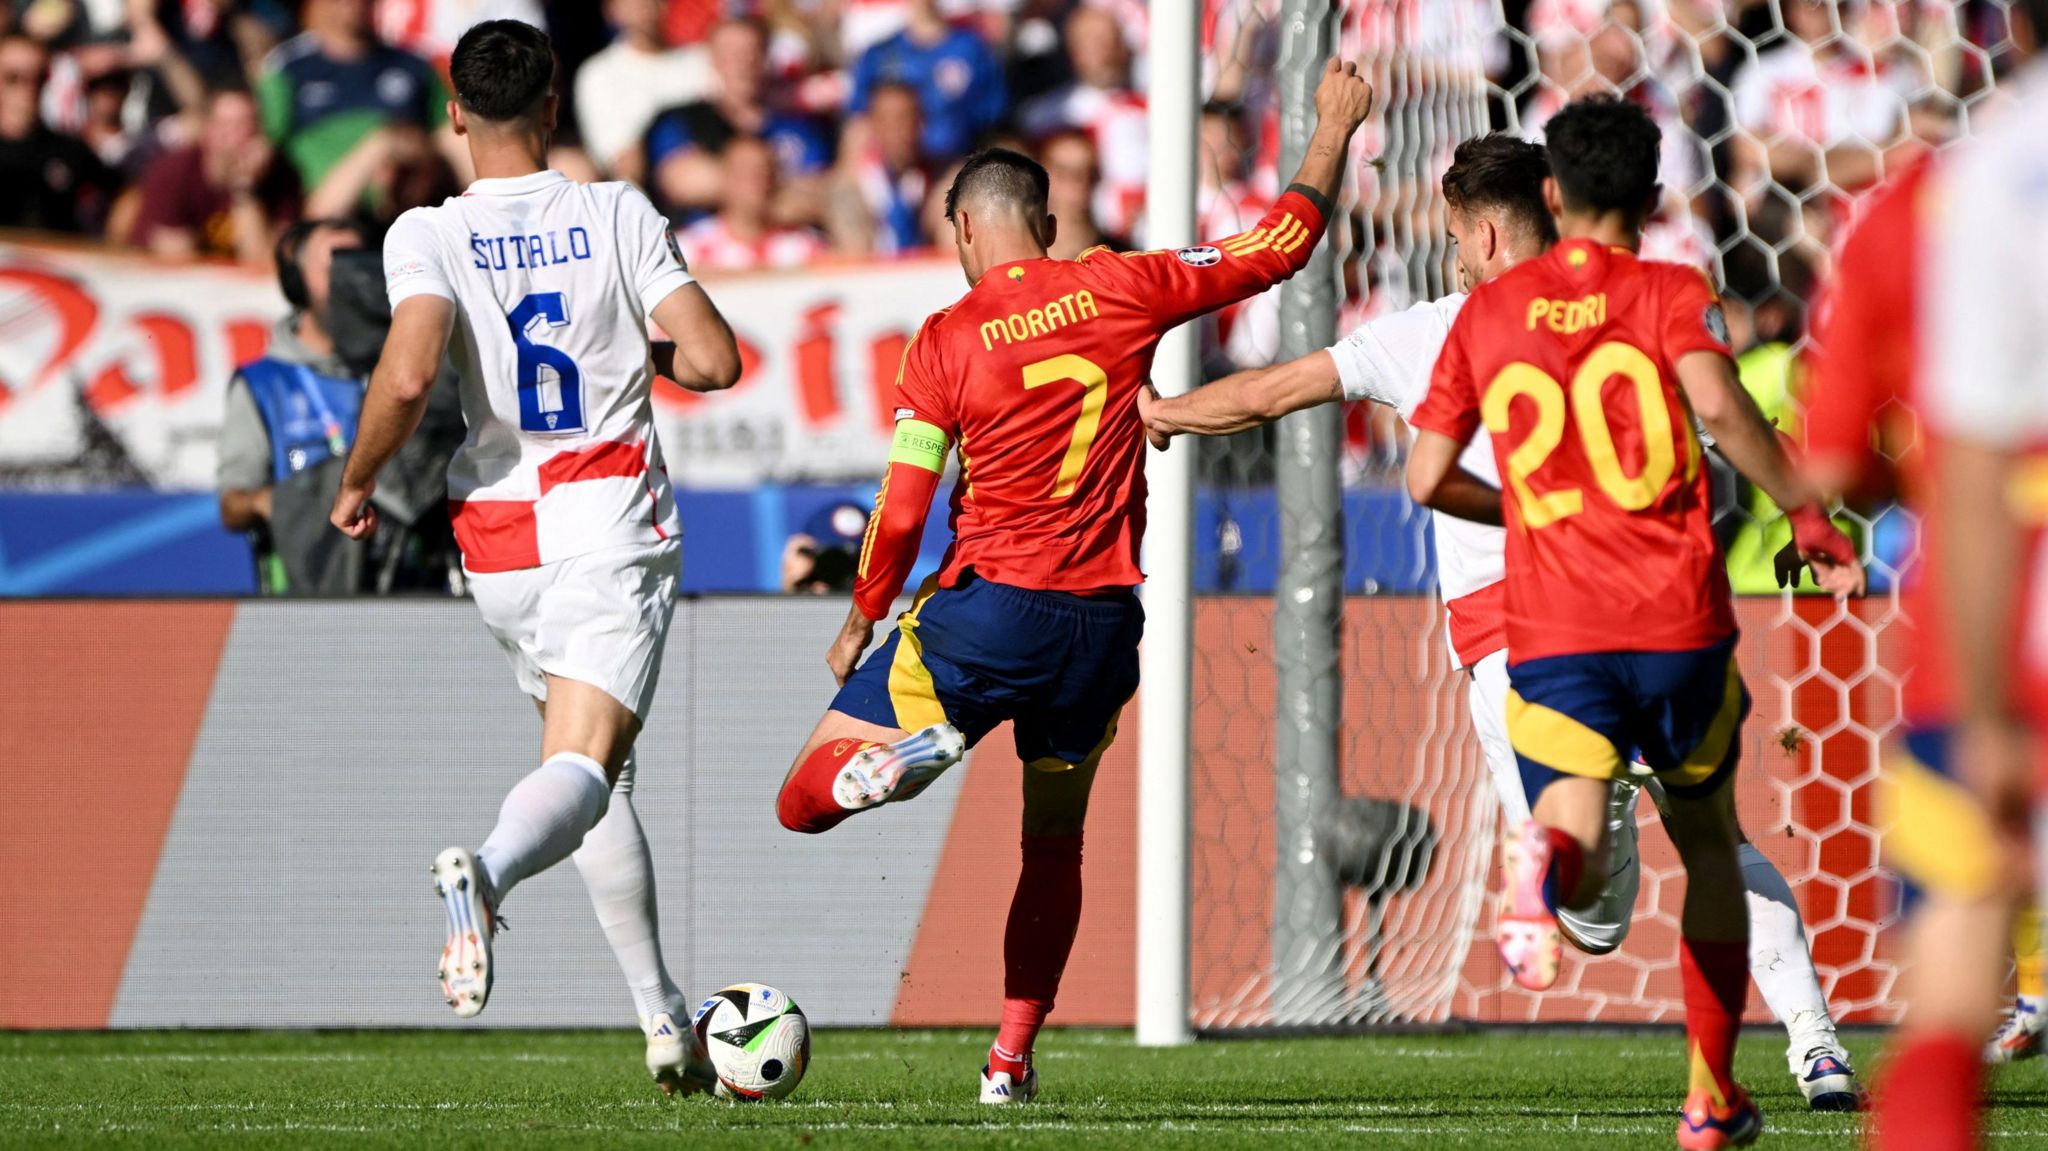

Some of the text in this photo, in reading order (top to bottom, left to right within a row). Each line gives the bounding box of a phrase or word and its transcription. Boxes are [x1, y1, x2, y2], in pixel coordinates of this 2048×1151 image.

[471, 226, 591, 270] ŠUTALO
[980, 289, 1099, 351] MORATA
[1526, 292, 1607, 334] PEDRI
[507, 291, 588, 436] 6
[912, 437, 948, 457] RESPEC
[1022, 353, 1107, 498] 7
[1481, 341, 1675, 529] 20
